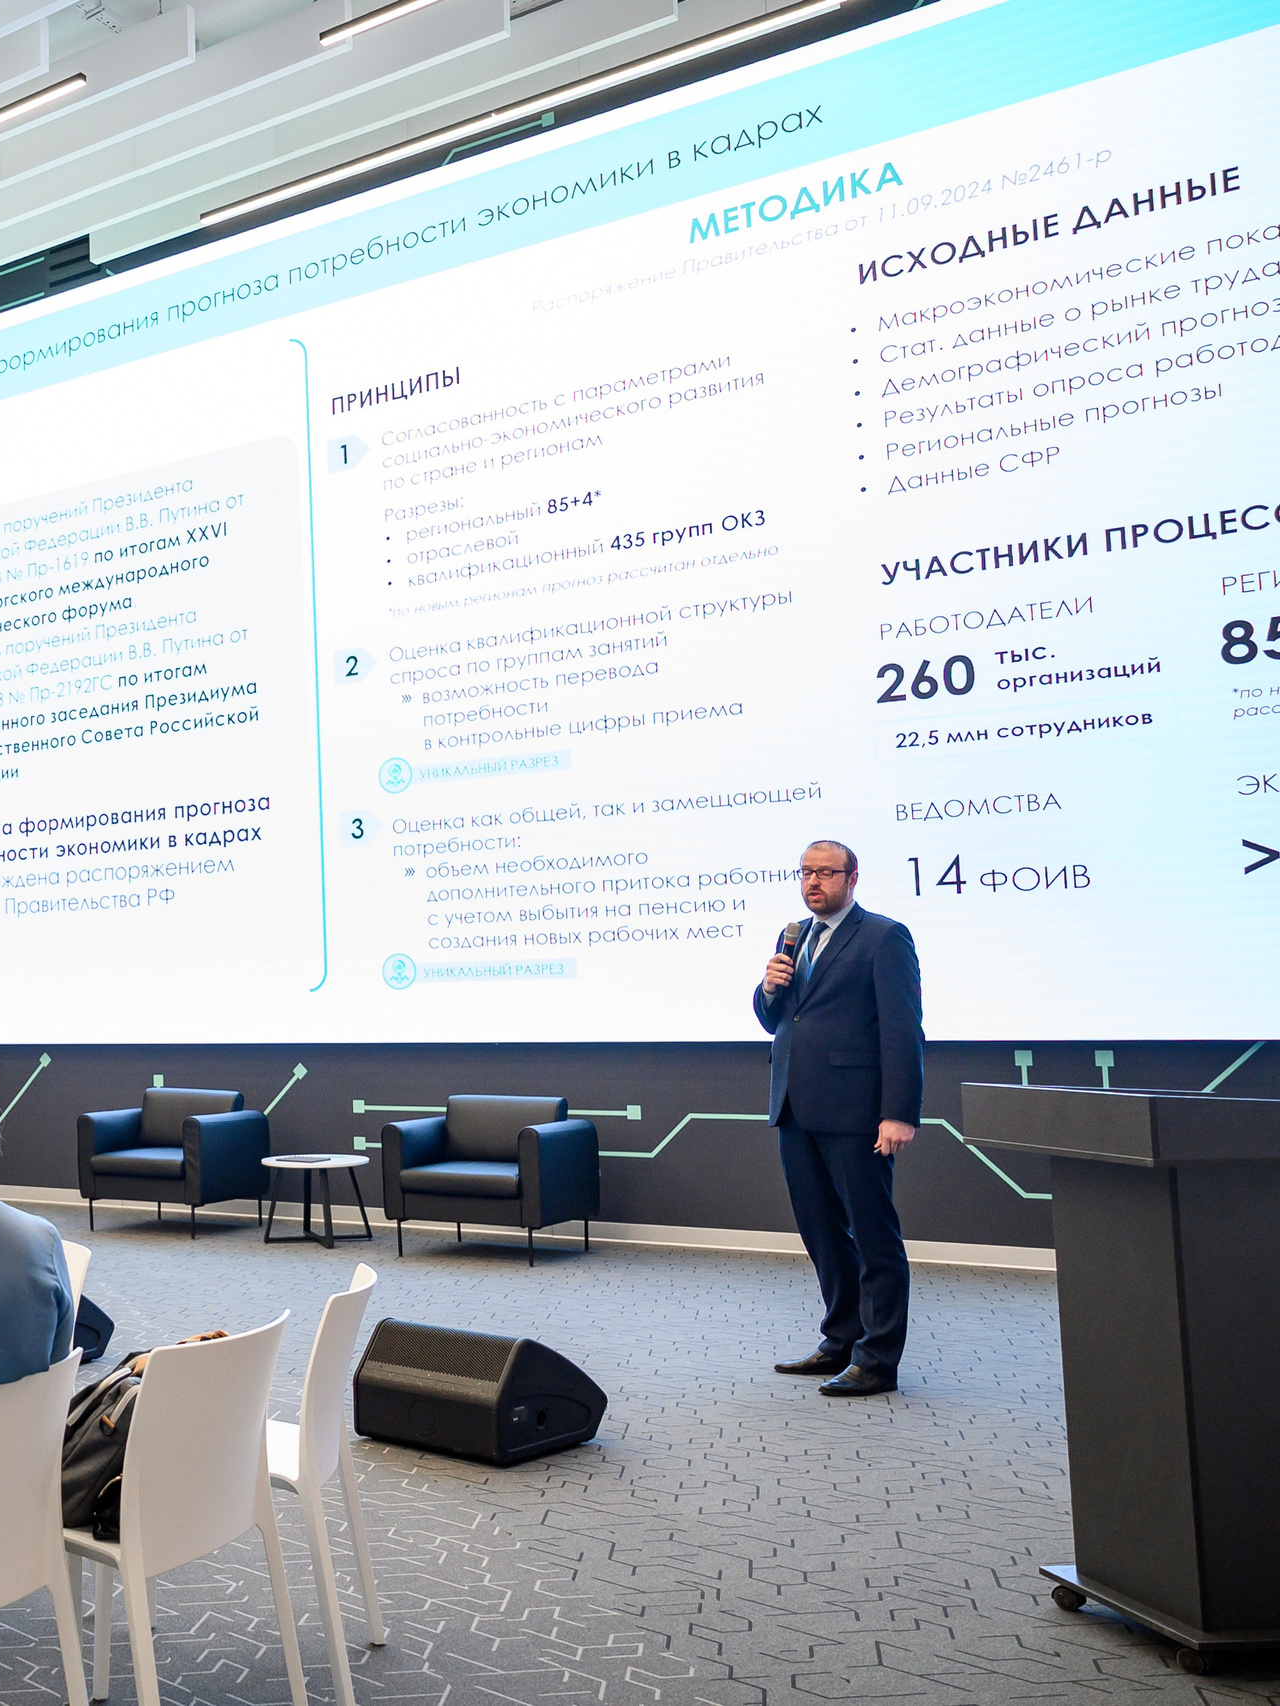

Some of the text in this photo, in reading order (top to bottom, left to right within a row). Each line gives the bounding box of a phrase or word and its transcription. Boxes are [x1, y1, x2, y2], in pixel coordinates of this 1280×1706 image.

[1001, 149, 1112, 190] №2461-р
[167, 273, 279, 323] прогноза
[288, 216, 466, 285] потребности
[477, 158, 654, 227] экономики
[667, 150, 682, 170] в
[693, 104, 823, 162] кадрах
[689, 163, 904, 244] МЕТОДИКА
[858, 166, 1241, 285] ИСХОДНЫЕ ДАННЫЕ
[878, 245, 1196, 332] Макроэкономические
[879, 260, 1280, 363] Стат. данные о рынке труда
[881, 321, 1151, 399] Демографический
[331, 366, 461, 416] ПРИНЦИПЫ
[381, 355, 731, 446] Согласованность параметрами
[884, 387, 1024, 428] Результаты
[1032, 363, 1144, 398] опроса
[382, 372, 765, 469] социально-экономического развития
[886, 383, 1222, 461] Региональные прогнозы
[340, 443, 348, 465] 1
[410, 434, 603, 486] стране регионам
[887, 446, 1060, 496] Данные СФР
[3, 500, 89, 534] поручений
[92, 479, 194, 514] Президента
[23, 522, 120, 553] Федерации
[125, 512, 153, 532] В.В.
[159, 499, 221, 524] Путина
[225, 493, 245, 510] от
[384, 496, 464, 522] Разрезы:
[406, 501, 541, 545] региональный
[27, 550, 89, 579] Пр-1619
[94, 549, 114, 564] по
[119, 535, 181, 558] итогам
[186, 521, 227, 545] XXVI
[406, 529, 519, 565] отраслевой
[408, 538, 604, 587] квалификационный
[610, 531, 645, 551] 435
[652, 522, 713, 547] групп
[607, 559, 696, 585] рассчитан
[700, 545, 779, 567] отдельно
[880, 532, 1089, 586] УЧАСТНИКИ
[58, 555, 210, 596] международного
[5, 626, 91, 655] поручений
[95, 610, 197, 641] Президента
[389, 590, 793, 663] Оценка квалификационной структуры
[879, 595, 1093, 641] РАБОТОДАТЕЛИ
[25, 651, 124, 676] Федерации
[128, 641, 157, 661] В.В.
[162, 632, 225, 655] Путина
[229, 628, 249, 644] от
[345, 655, 359, 678] 2
[389, 631, 668, 686] спроса по группам занятий
[994, 646, 1056, 665] тыс.
[29, 674, 113, 703] Пр-2192ГС
[118, 673, 139, 688] по
[143, 663, 208, 684] итогам
[422, 661, 659, 705] возможность перевода
[876, 654, 976, 704] 260
[996, 656, 1161, 693] организаций
[50, 699, 139, 724] заседания
[145, 682, 258, 712] Президиума
[81, 725, 144, 745] Совета
[149, 705, 259, 736] Российской
[423, 701, 549, 728] потребности
[438, 702, 743, 749] контрольные цифры приема
[895, 713, 1153, 749] 22,5 млн сотрудников
[419, 754, 560, 781] УНИКАЛЬНЫЙ РАЗРЕЗ
[18, 807, 167, 838] формирования
[174, 796, 270, 822] прогноза
[351, 817, 365, 840] 3
[392, 781, 822, 835] Оценка как общей, так и замещающей
[895, 792, 1062, 822] ВЕДОМСТВА
[55, 836, 160, 858] экономики
[168, 834, 178, 848] в
[184, 826, 262, 848] кадрах
[392, 835, 521, 859] потребности:
[66, 858, 235, 888] распоряжением
[425, 851, 649, 879] объем необходимого
[426, 868, 799, 903] дополнительного притока работни
[907, 853, 967, 897] 14
[979, 864, 1091, 893] ФОИВ
[4, 887, 176, 918] Правительства РФ
[444, 899, 726, 929] учетом выбытия на пенсию
[428, 924, 744, 950] создания новых рабочих мест
[422, 961, 565, 980] УНИКАЛЬНЫЙ РАЗРЕЗ
